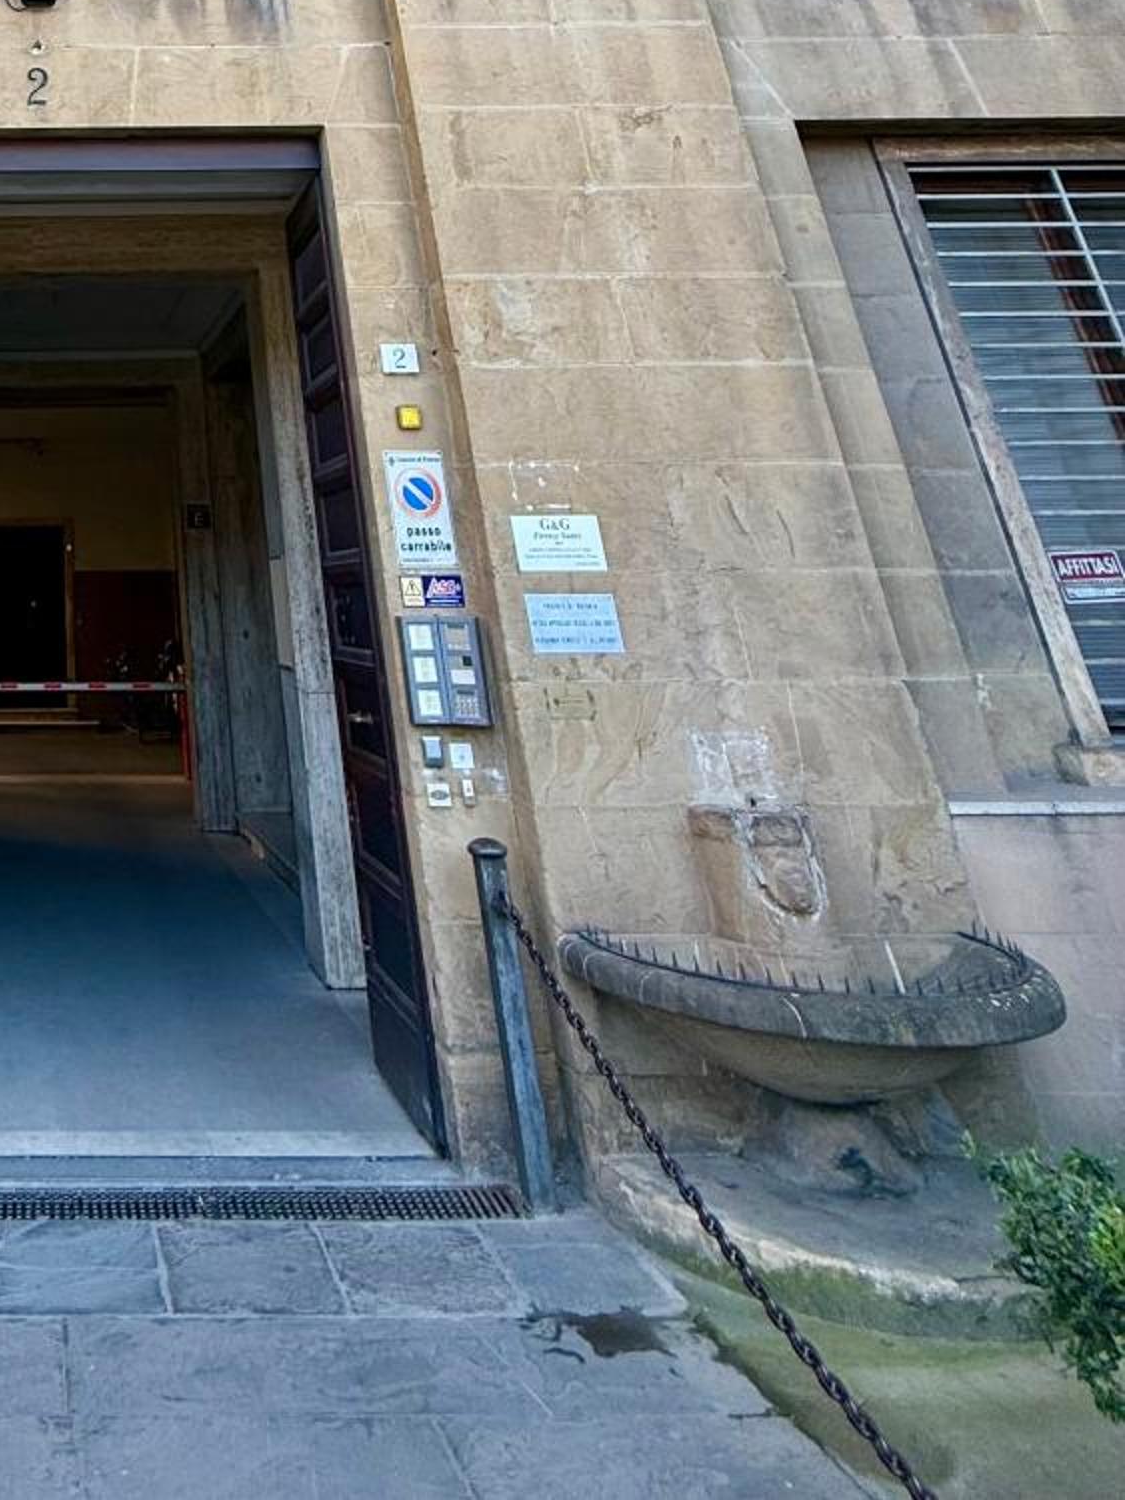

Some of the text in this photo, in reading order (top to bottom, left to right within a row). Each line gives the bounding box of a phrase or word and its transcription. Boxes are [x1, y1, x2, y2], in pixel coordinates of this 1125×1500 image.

[27, 67, 48, 106] 2
[392, 350, 407, 369] 2
[539, 517, 570, 531] G&G
[406, 527, 442, 538] passo
[400, 539, 452, 551] carrabile
[1051, 556, 1120, 577] AFFITTASI
